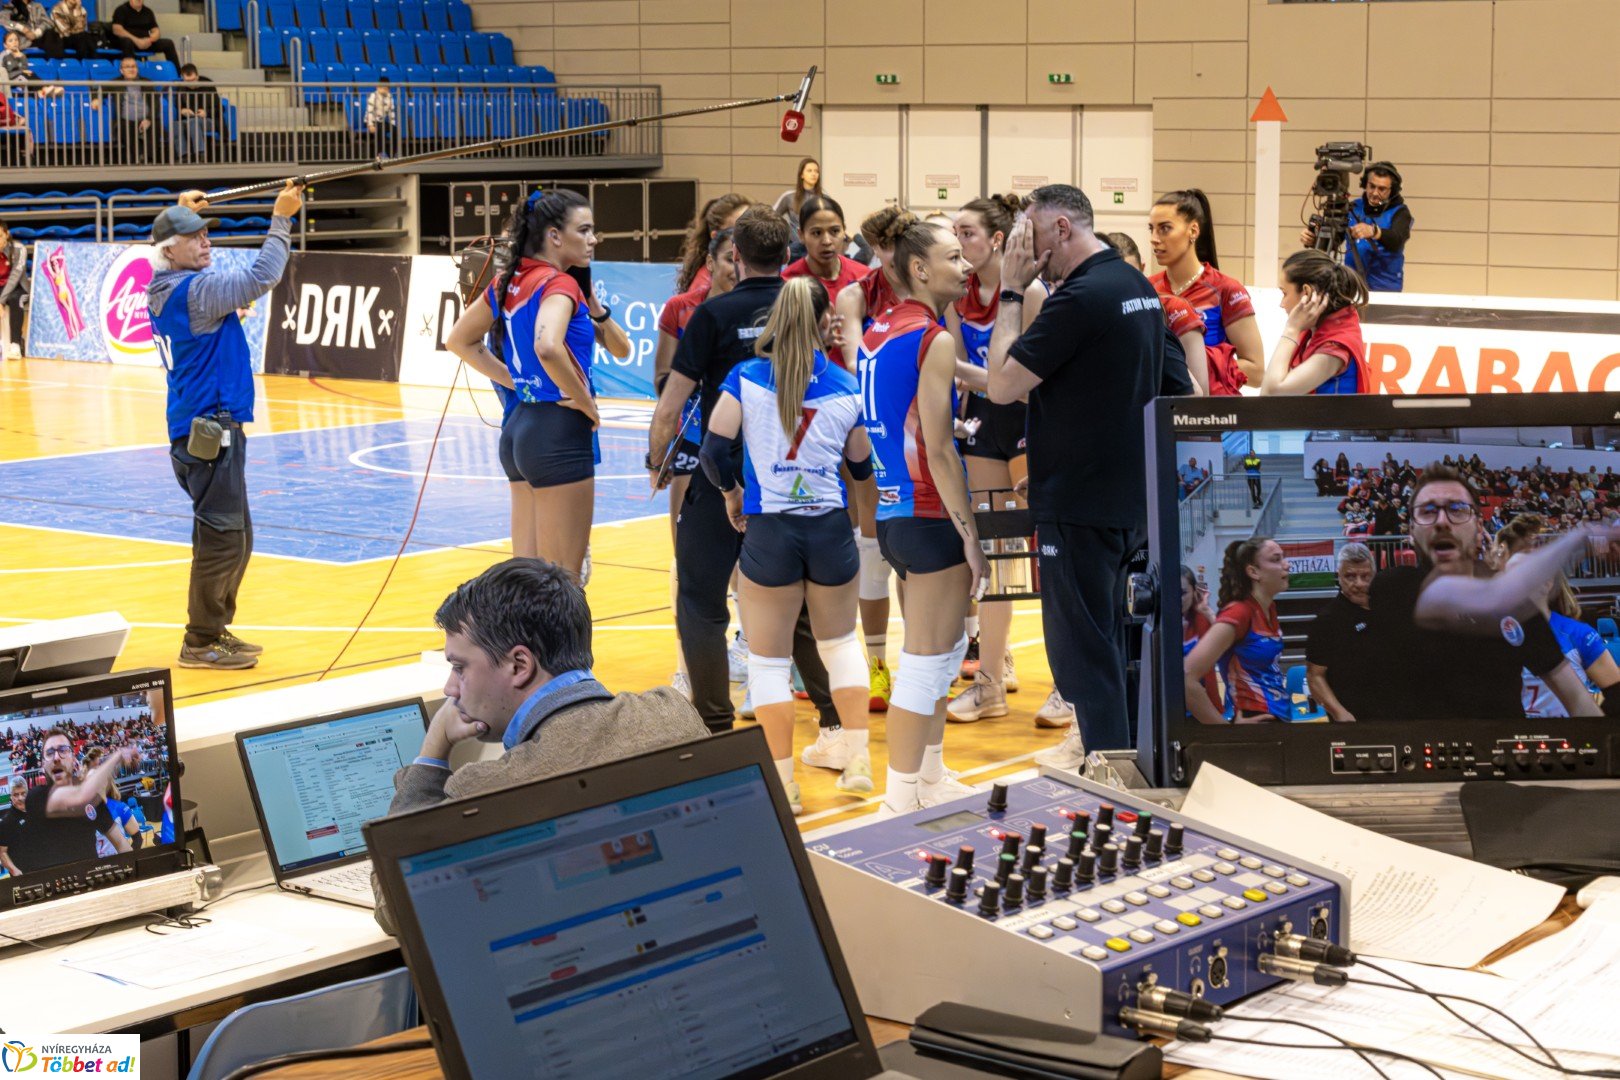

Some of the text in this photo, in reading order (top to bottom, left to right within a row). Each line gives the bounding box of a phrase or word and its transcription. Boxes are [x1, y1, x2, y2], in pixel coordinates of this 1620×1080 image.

[624, 301, 666, 331] GY
[859, 358, 878, 421] 11
[1173, 414, 1237, 425] Marshall
[786, 408, 818, 461] 7
[674, 452, 700, 471] 22
[1288, 557, 1330, 572] GYHÁZA
